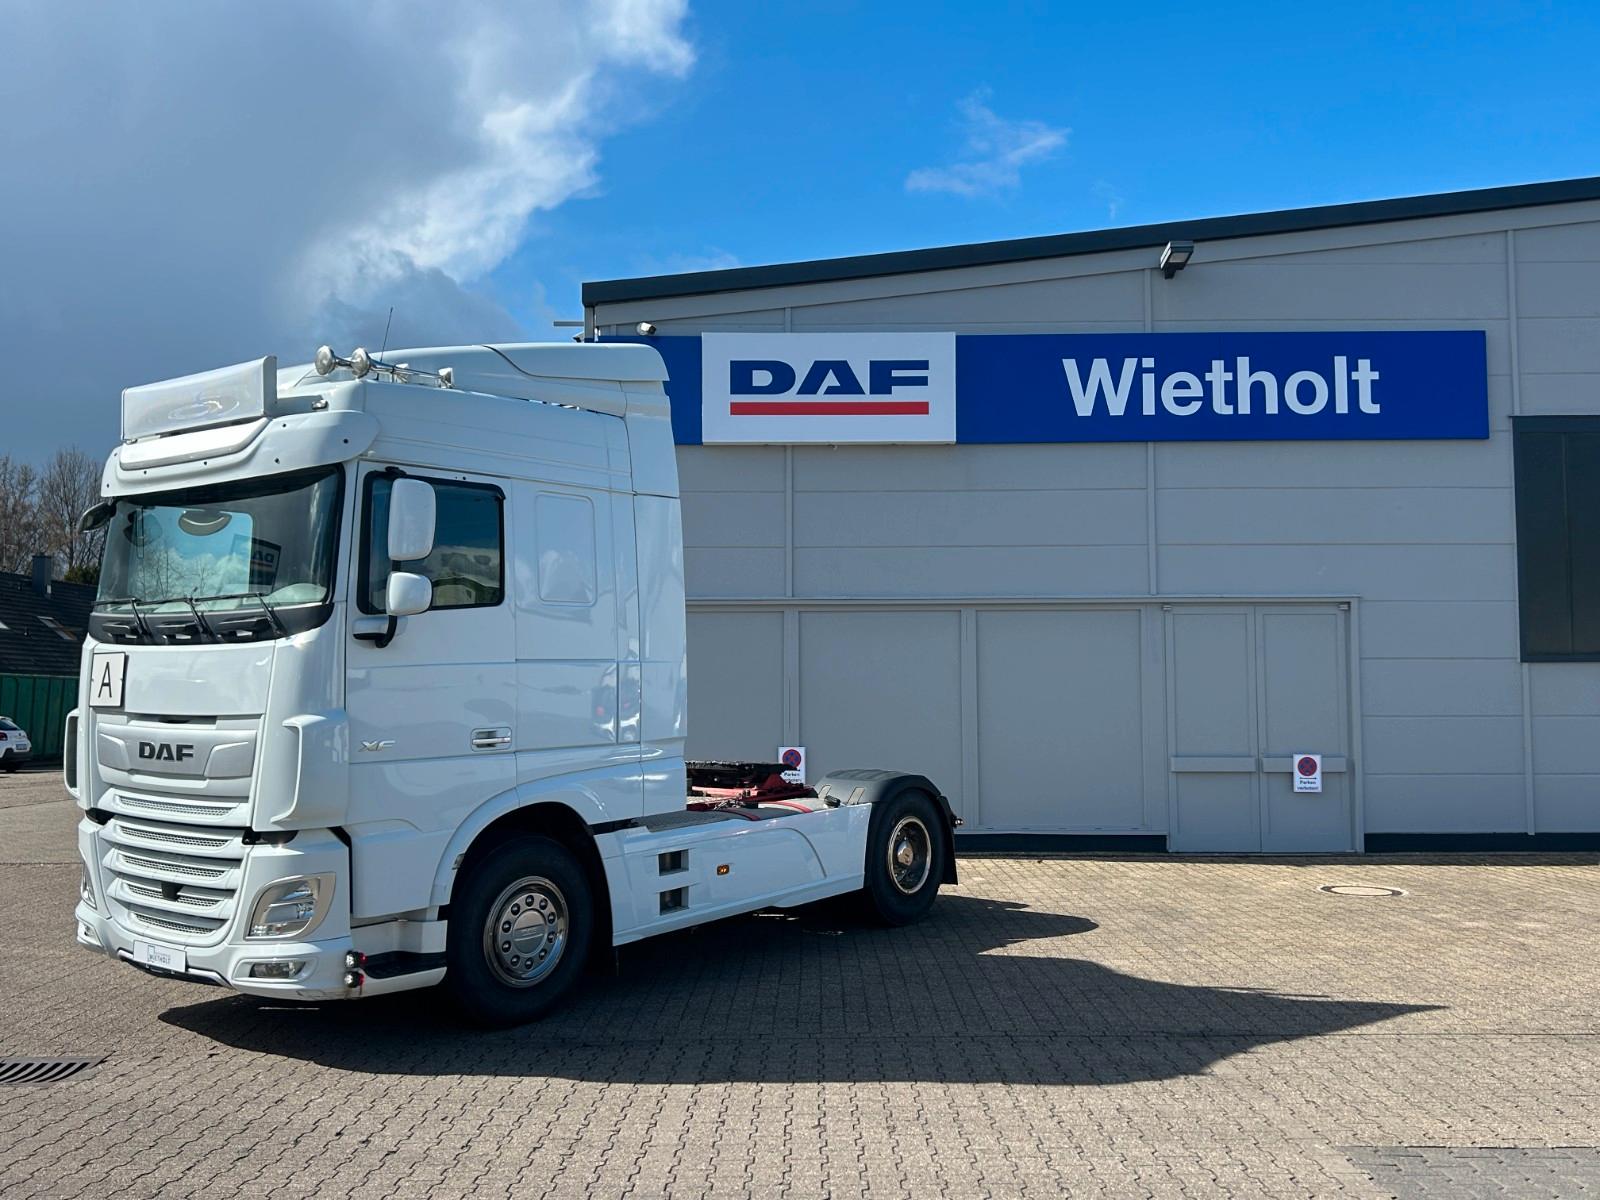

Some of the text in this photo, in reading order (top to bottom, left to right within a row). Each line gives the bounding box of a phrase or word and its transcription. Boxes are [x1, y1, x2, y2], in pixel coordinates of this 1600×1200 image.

[730, 360, 929, 395] DAF
[1062, 356, 1381, 417] Wietholt
[98, 661, 113, 698] A
[138, 741, 194, 762] DAF
[358, 740, 396, 752] XF
